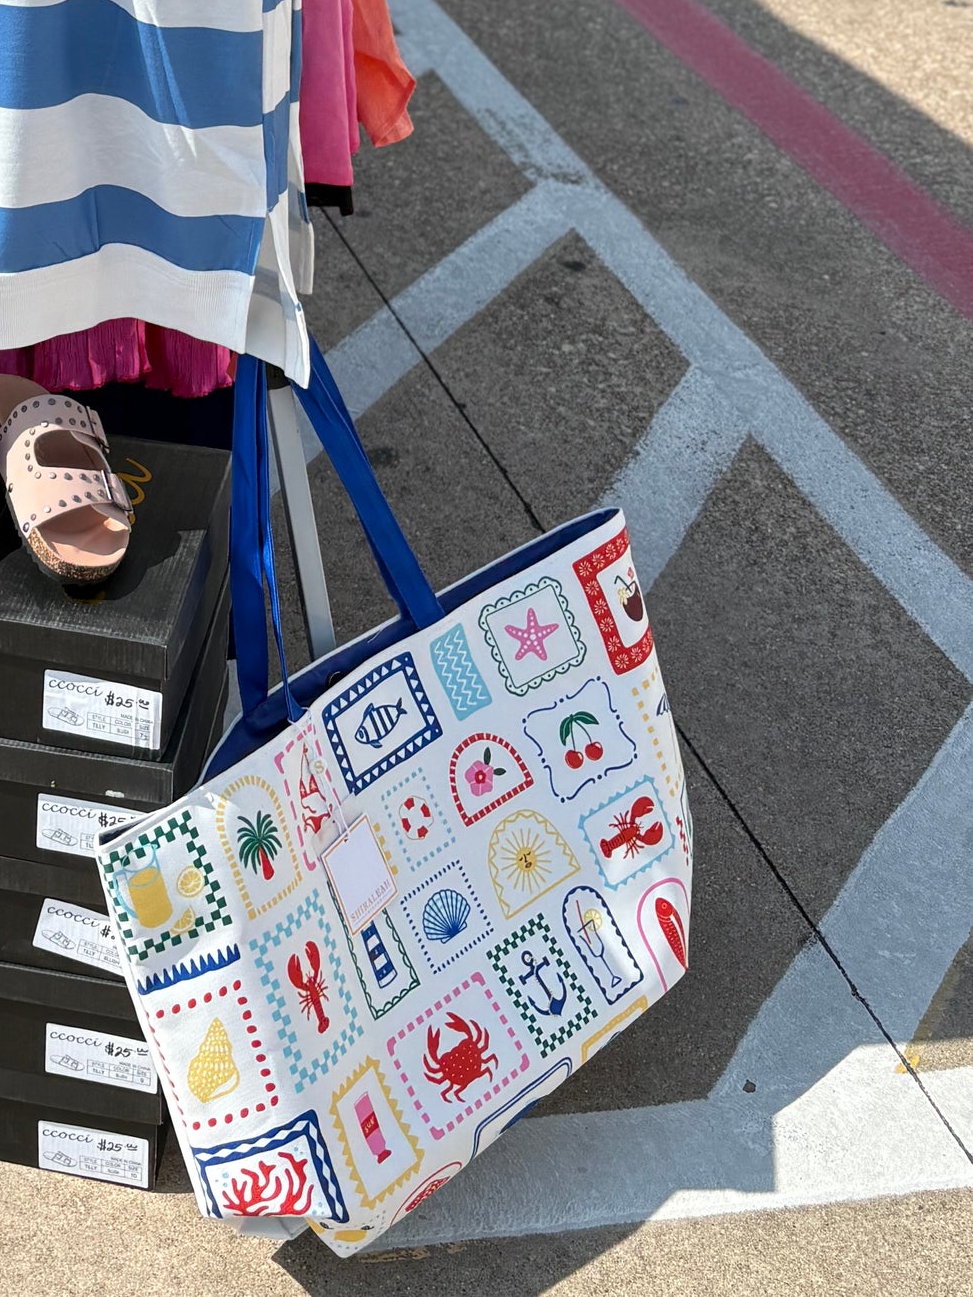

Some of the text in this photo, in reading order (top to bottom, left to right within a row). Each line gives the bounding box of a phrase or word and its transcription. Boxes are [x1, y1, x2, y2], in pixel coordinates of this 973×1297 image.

[48, 679, 104, 697] ccocci
[42, 803, 97, 819] ccocci
[350, 879, 392, 922] SHIRALEAH
[47, 906, 100, 928] ccocci
[50, 1031, 103, 1047] ccocci
[42, 1129, 94, 1143] ccocci
